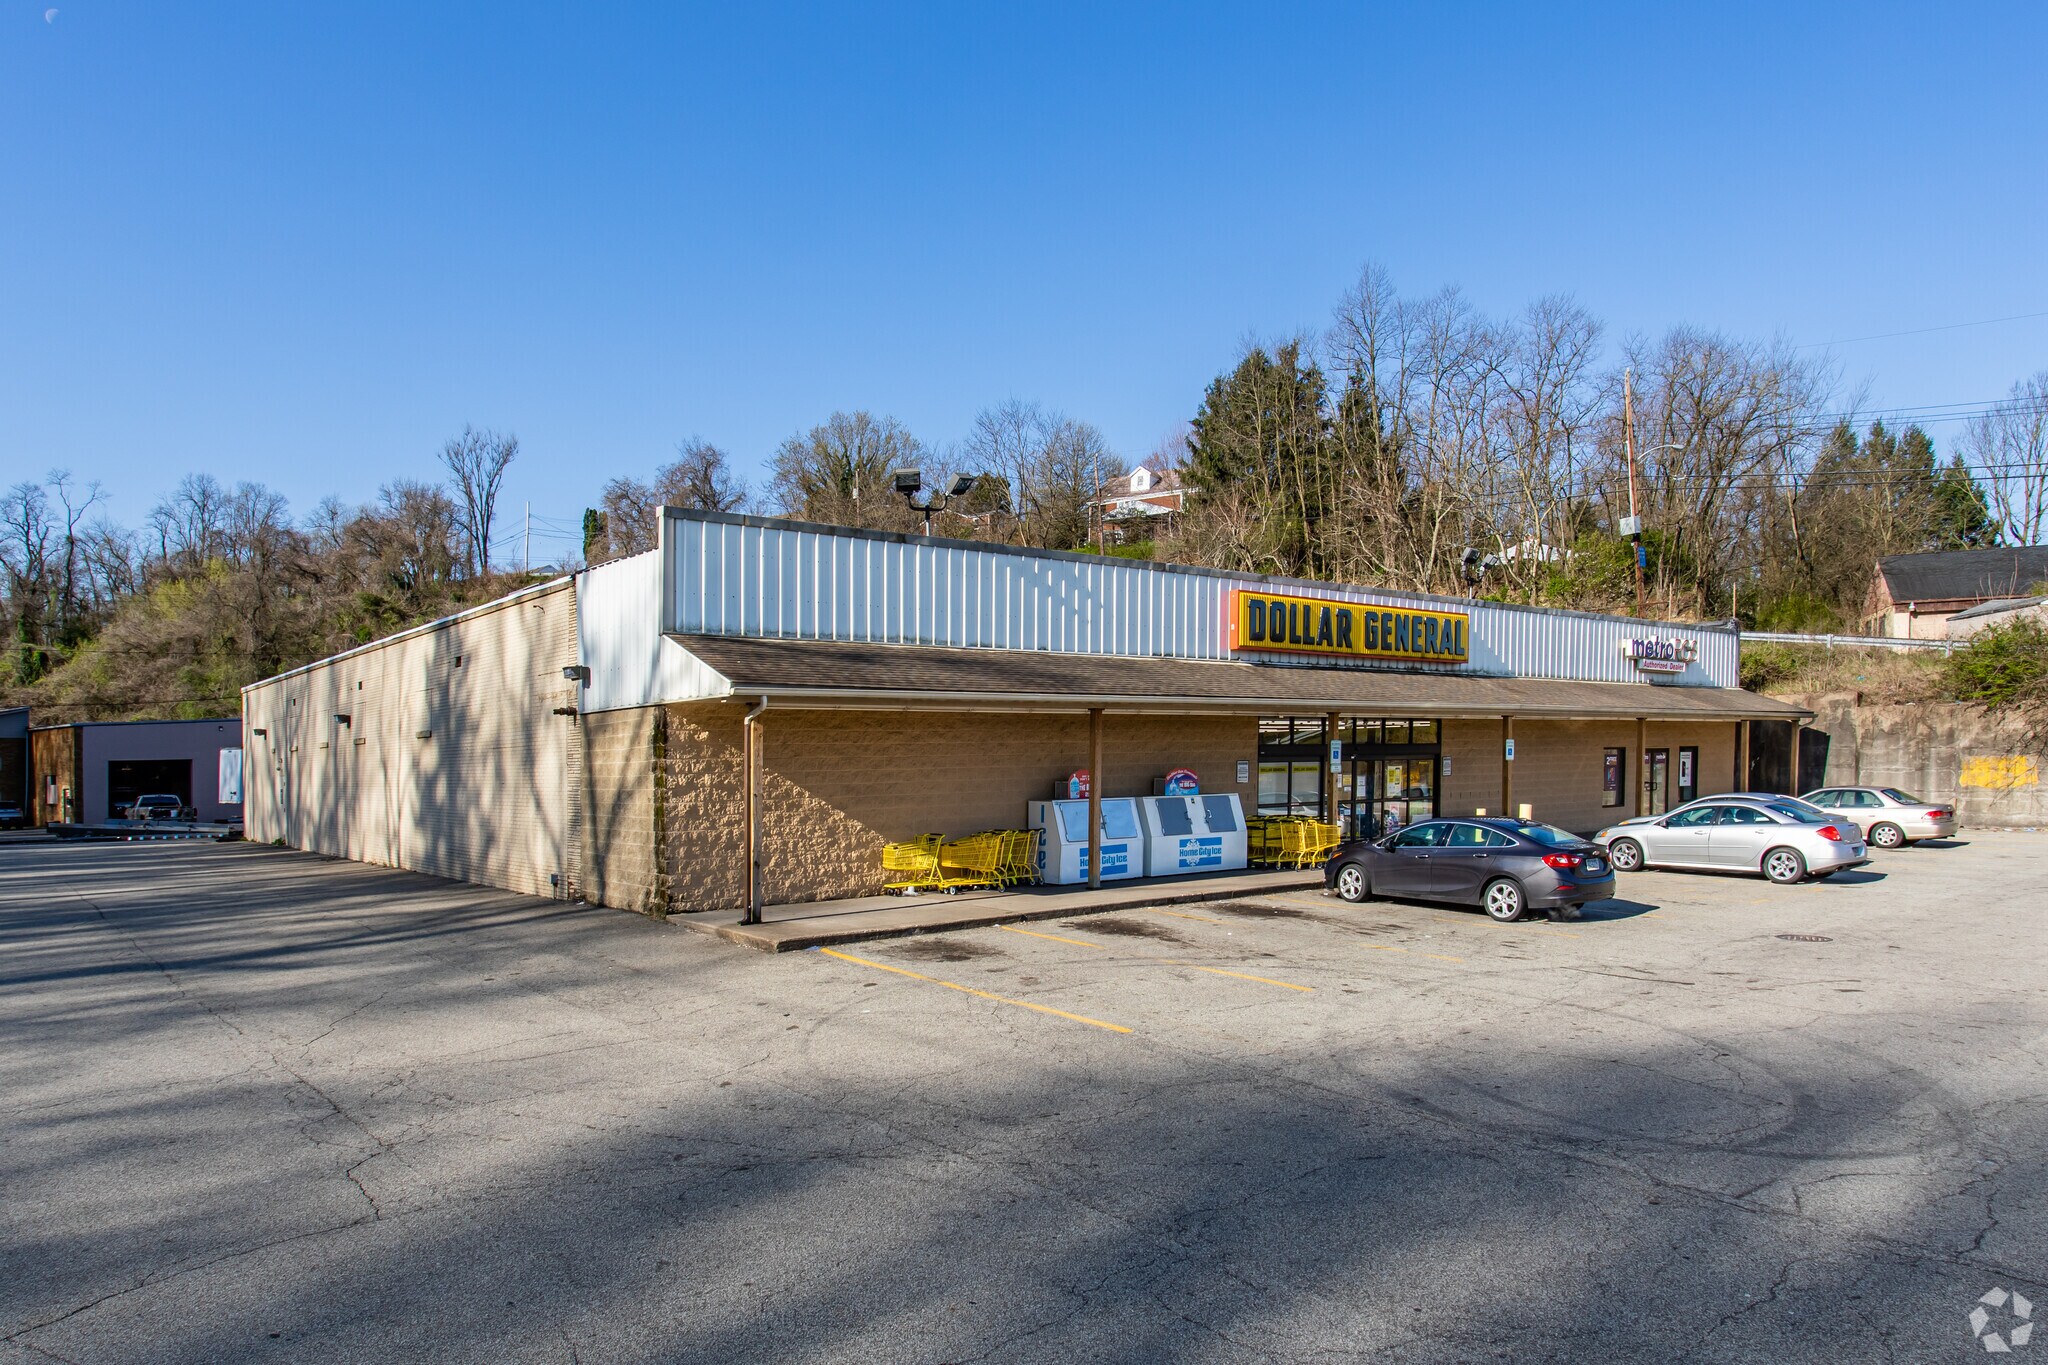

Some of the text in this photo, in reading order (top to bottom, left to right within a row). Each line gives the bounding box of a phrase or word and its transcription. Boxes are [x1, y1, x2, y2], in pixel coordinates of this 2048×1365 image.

[1249, 599, 1465, 656] DOLLAR GENERAL
[1643, 660, 1684, 671] Authorized Dealer
[1179, 846, 1222, 857] Home City Ice
[1079, 854, 1128, 867] Ho City Ice
